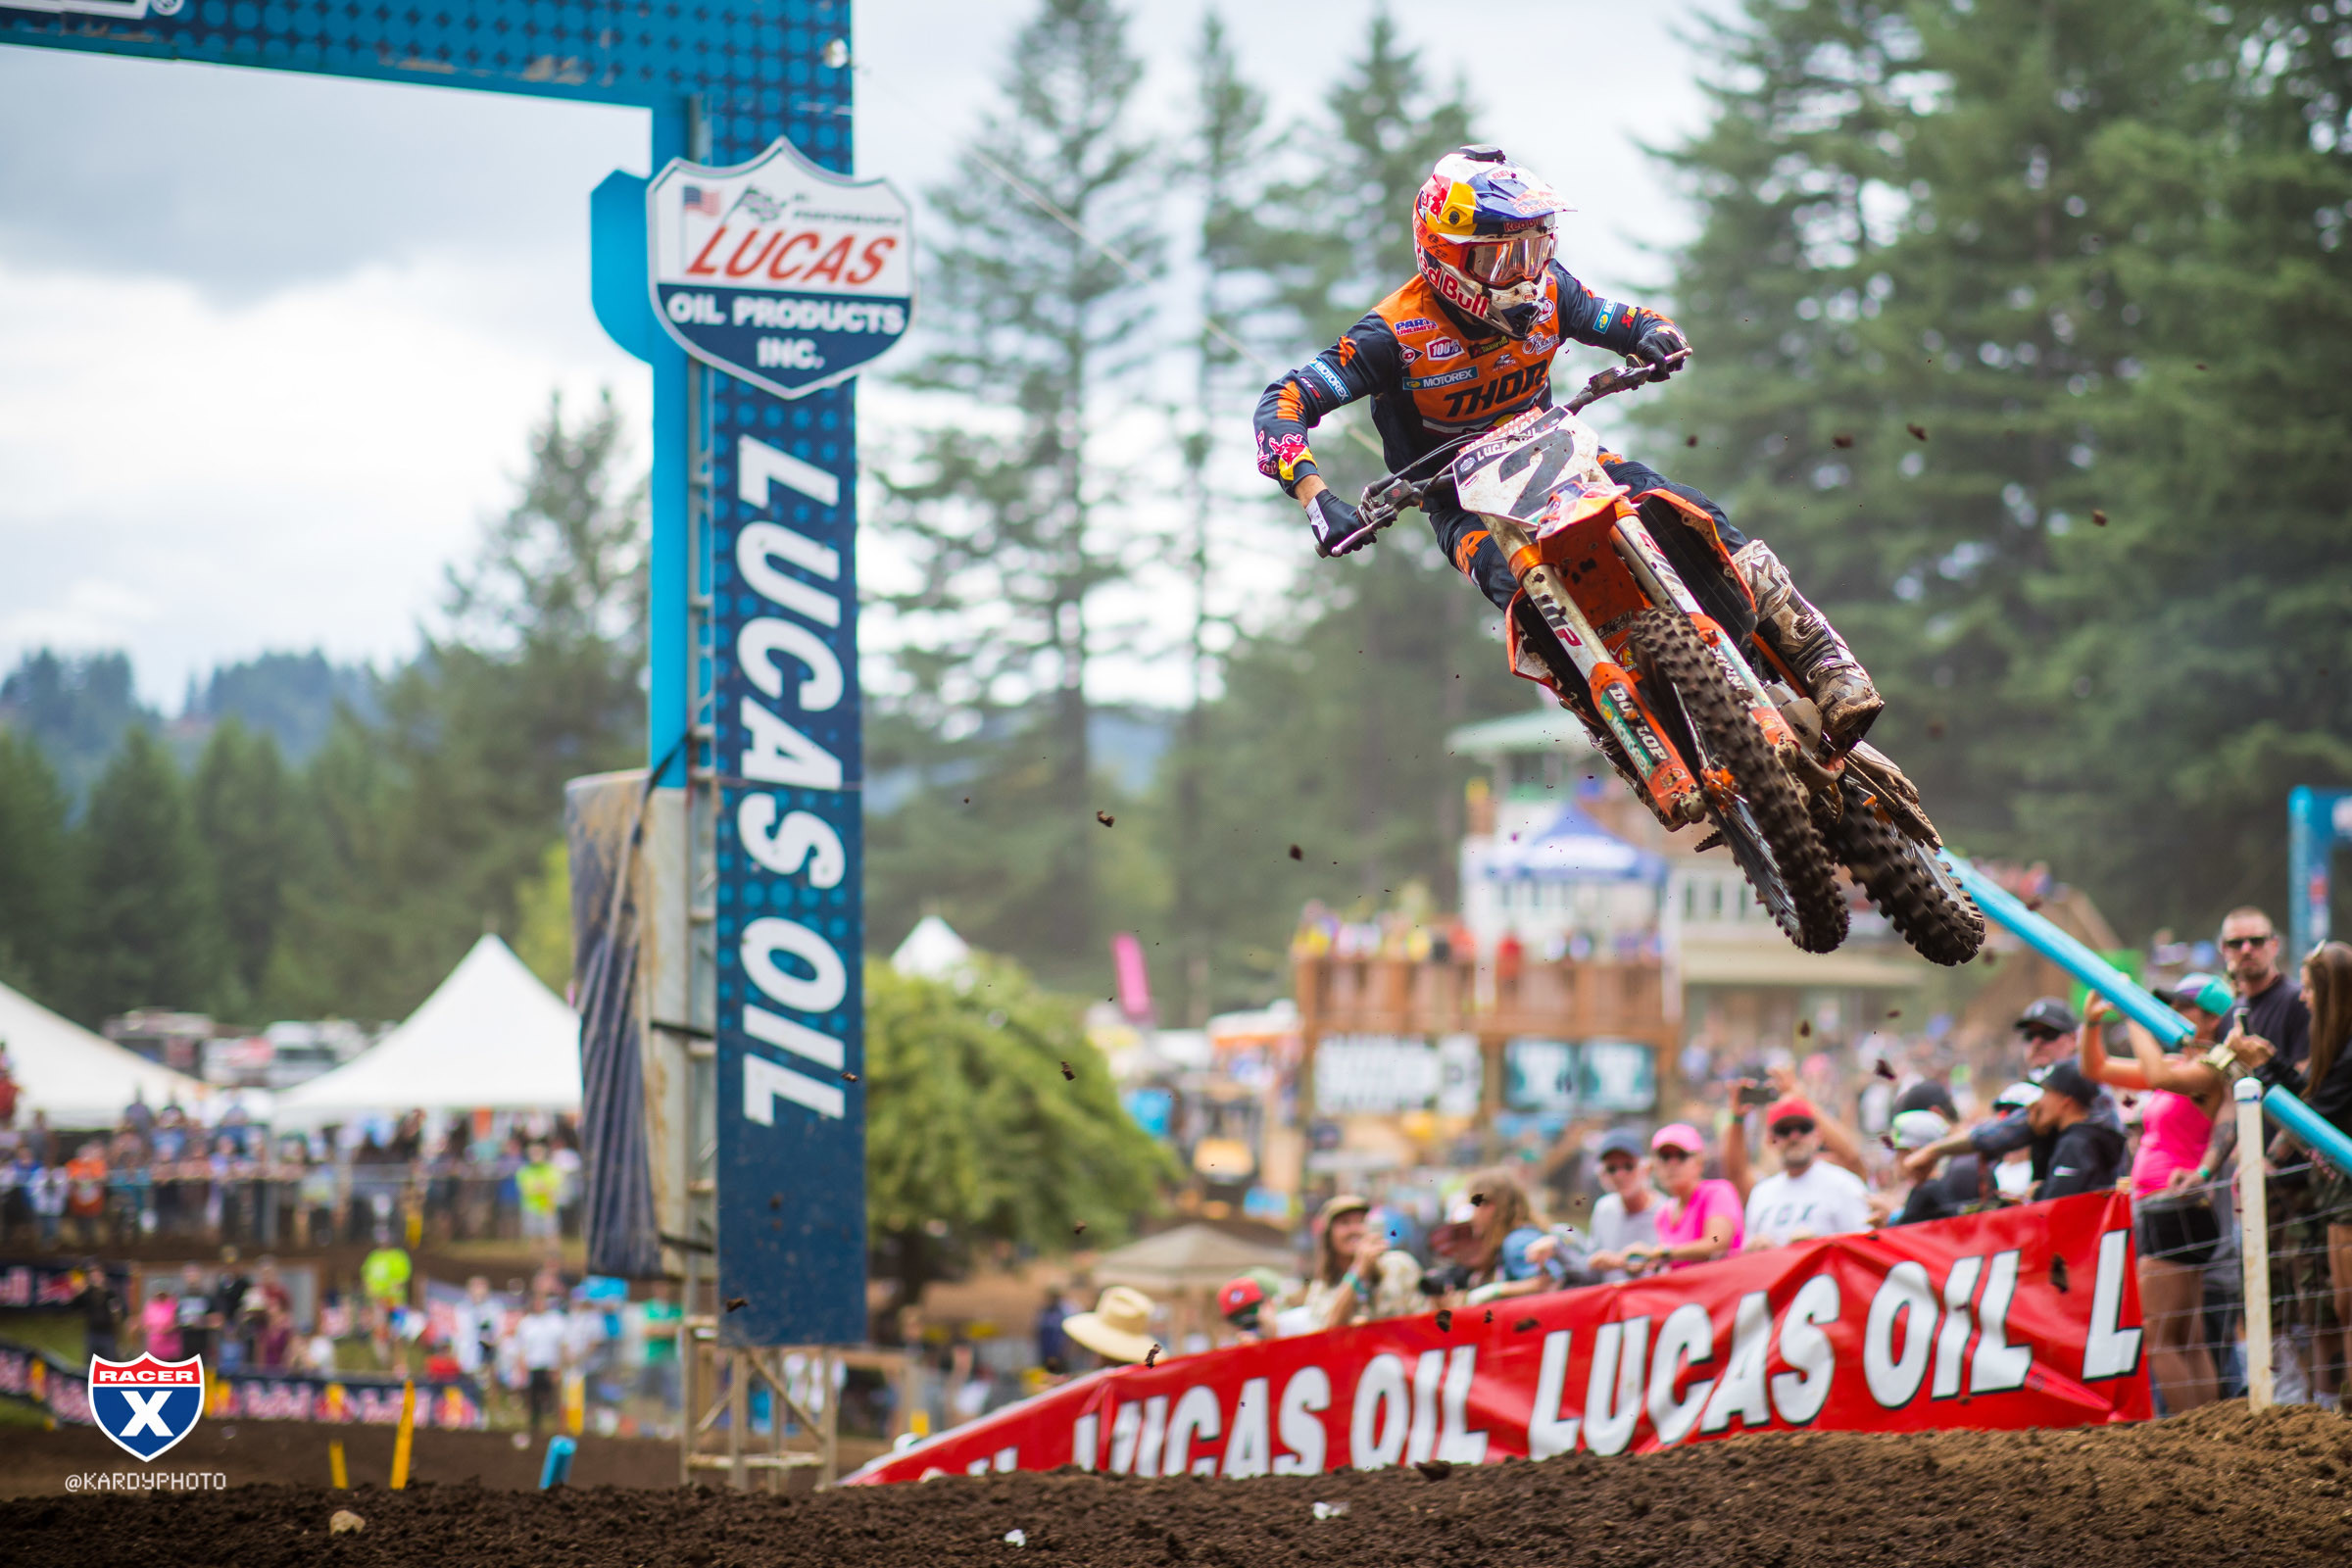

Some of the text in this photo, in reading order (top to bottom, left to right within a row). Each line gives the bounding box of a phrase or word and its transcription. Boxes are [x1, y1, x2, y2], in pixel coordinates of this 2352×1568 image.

[685, 224, 898, 285] LUCAS
[666, 292, 906, 335] OIL PRODUCTS
[1441, 272, 1489, 318] Bull
[757, 337, 825, 368] INC.
[1432, 341, 1459, 358] 100%
[1315, 362, 1349, 401] MOTOREX
[1423, 368, 1474, 388] MOTOREX
[1443, 359, 1548, 418] THOR
[1476, 439, 1515, 463] LUCA
[1498, 428, 1583, 519] 2
[1608, 688, 1668, 760] DULOP
[736, 433, 848, 1128] LUCAS OIL
[1349, 1344, 1489, 1472] OIL
[1528, 1273, 1839, 1461] LUCAS
[1864, 1249, 2033, 1409] OIL
